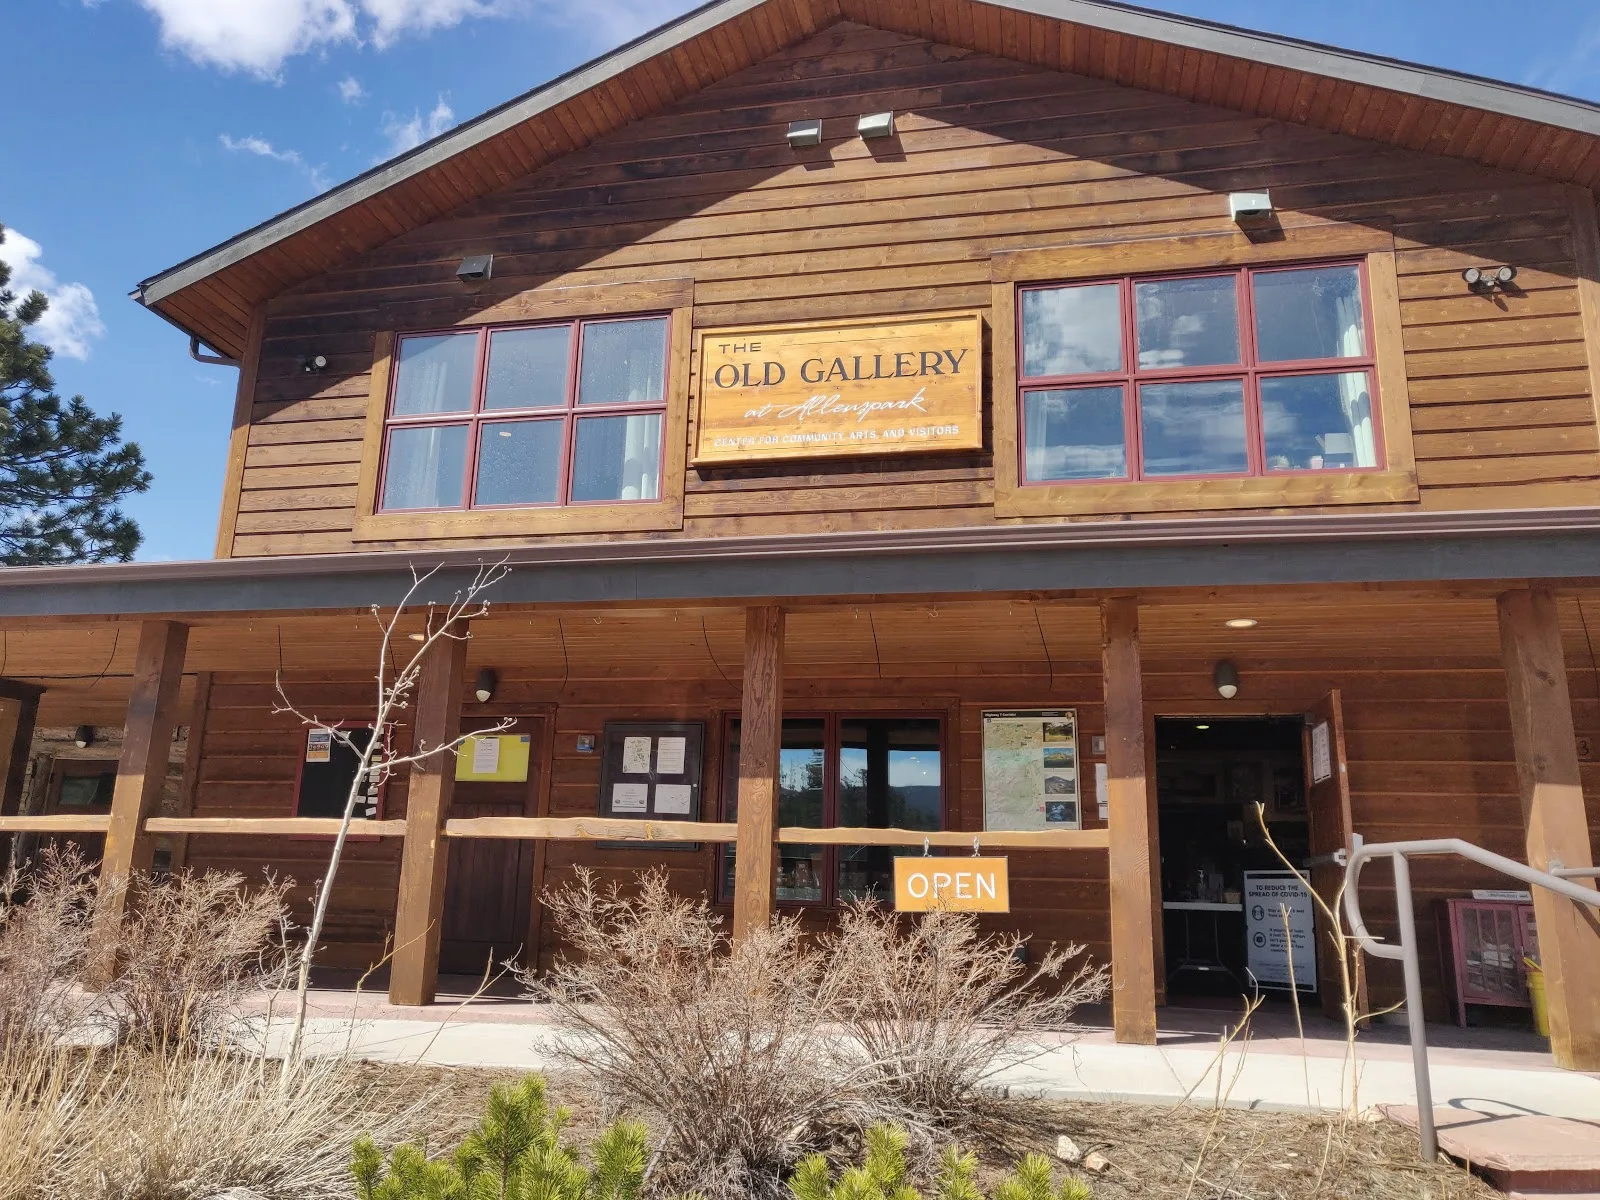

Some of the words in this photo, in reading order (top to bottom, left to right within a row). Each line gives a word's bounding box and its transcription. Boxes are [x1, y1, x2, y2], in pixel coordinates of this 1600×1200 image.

[718, 342, 762, 354] THE
[714, 361, 786, 388] OLD
[800, 348, 968, 383] GALLERY
[744, 402, 778, 419] at
[777, 387, 927, 423] Allenspark
[714, 437, 755, 447] CENTER
[759, 435, 779, 445] FOR
[883, 428, 905, 438] AND
[908, 425, 959, 437] VISITORS
[1580, 740, 1590, 756] 3
[907, 872, 996, 899] OPEN
